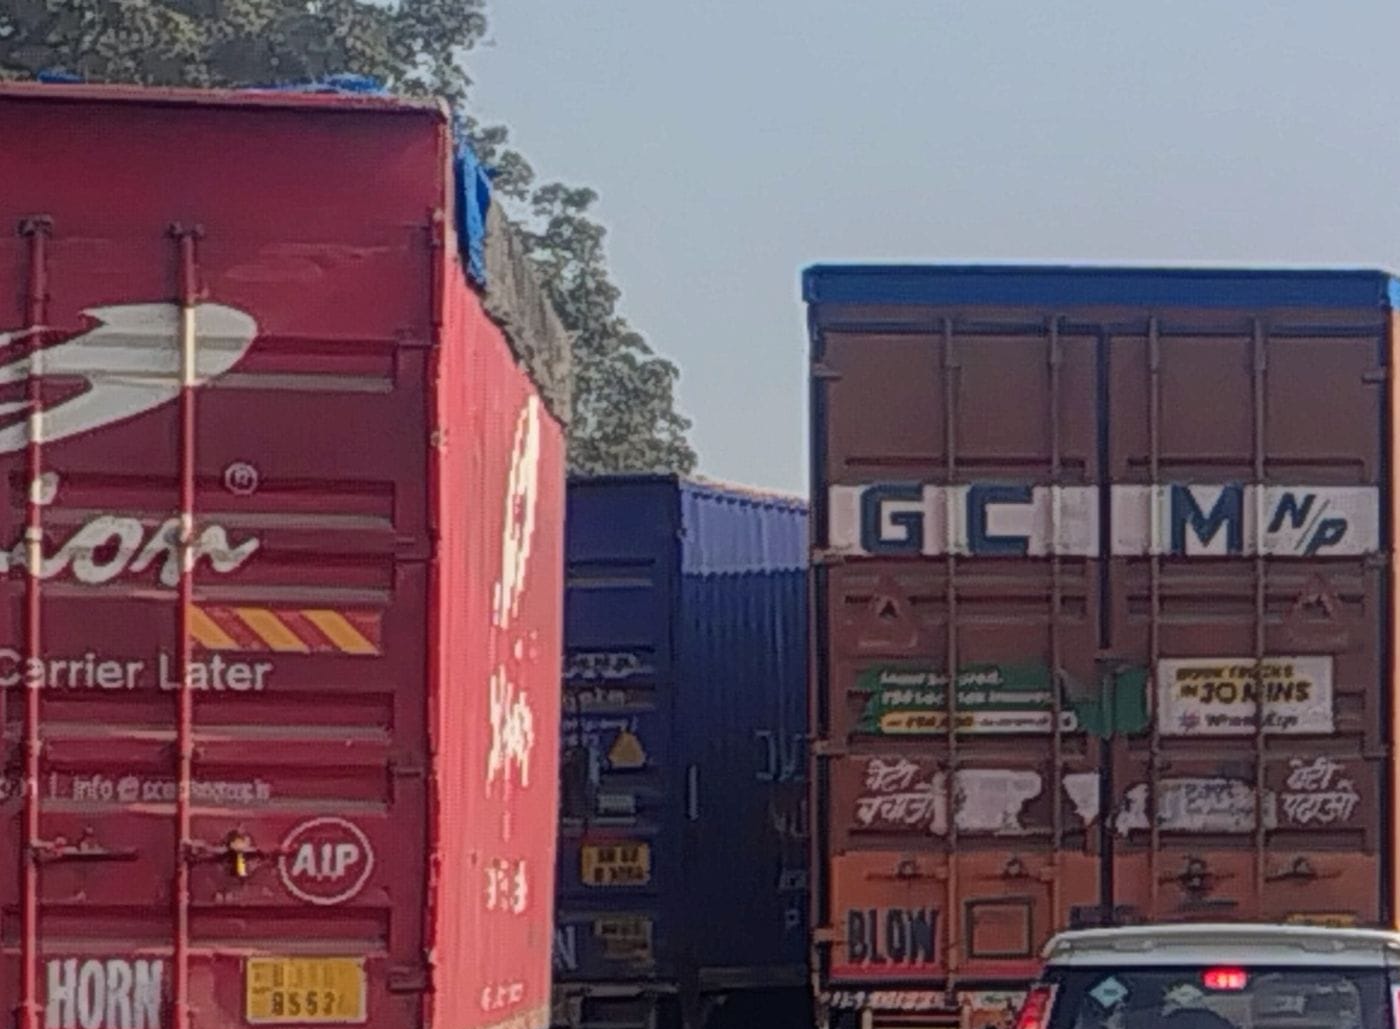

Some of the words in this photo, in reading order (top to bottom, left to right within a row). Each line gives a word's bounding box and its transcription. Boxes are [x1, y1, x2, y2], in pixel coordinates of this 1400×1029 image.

[0, 648, 144, 690] Carrier
[159, 652, 272, 691] Later
[848, 907, 940, 966] BLOW
